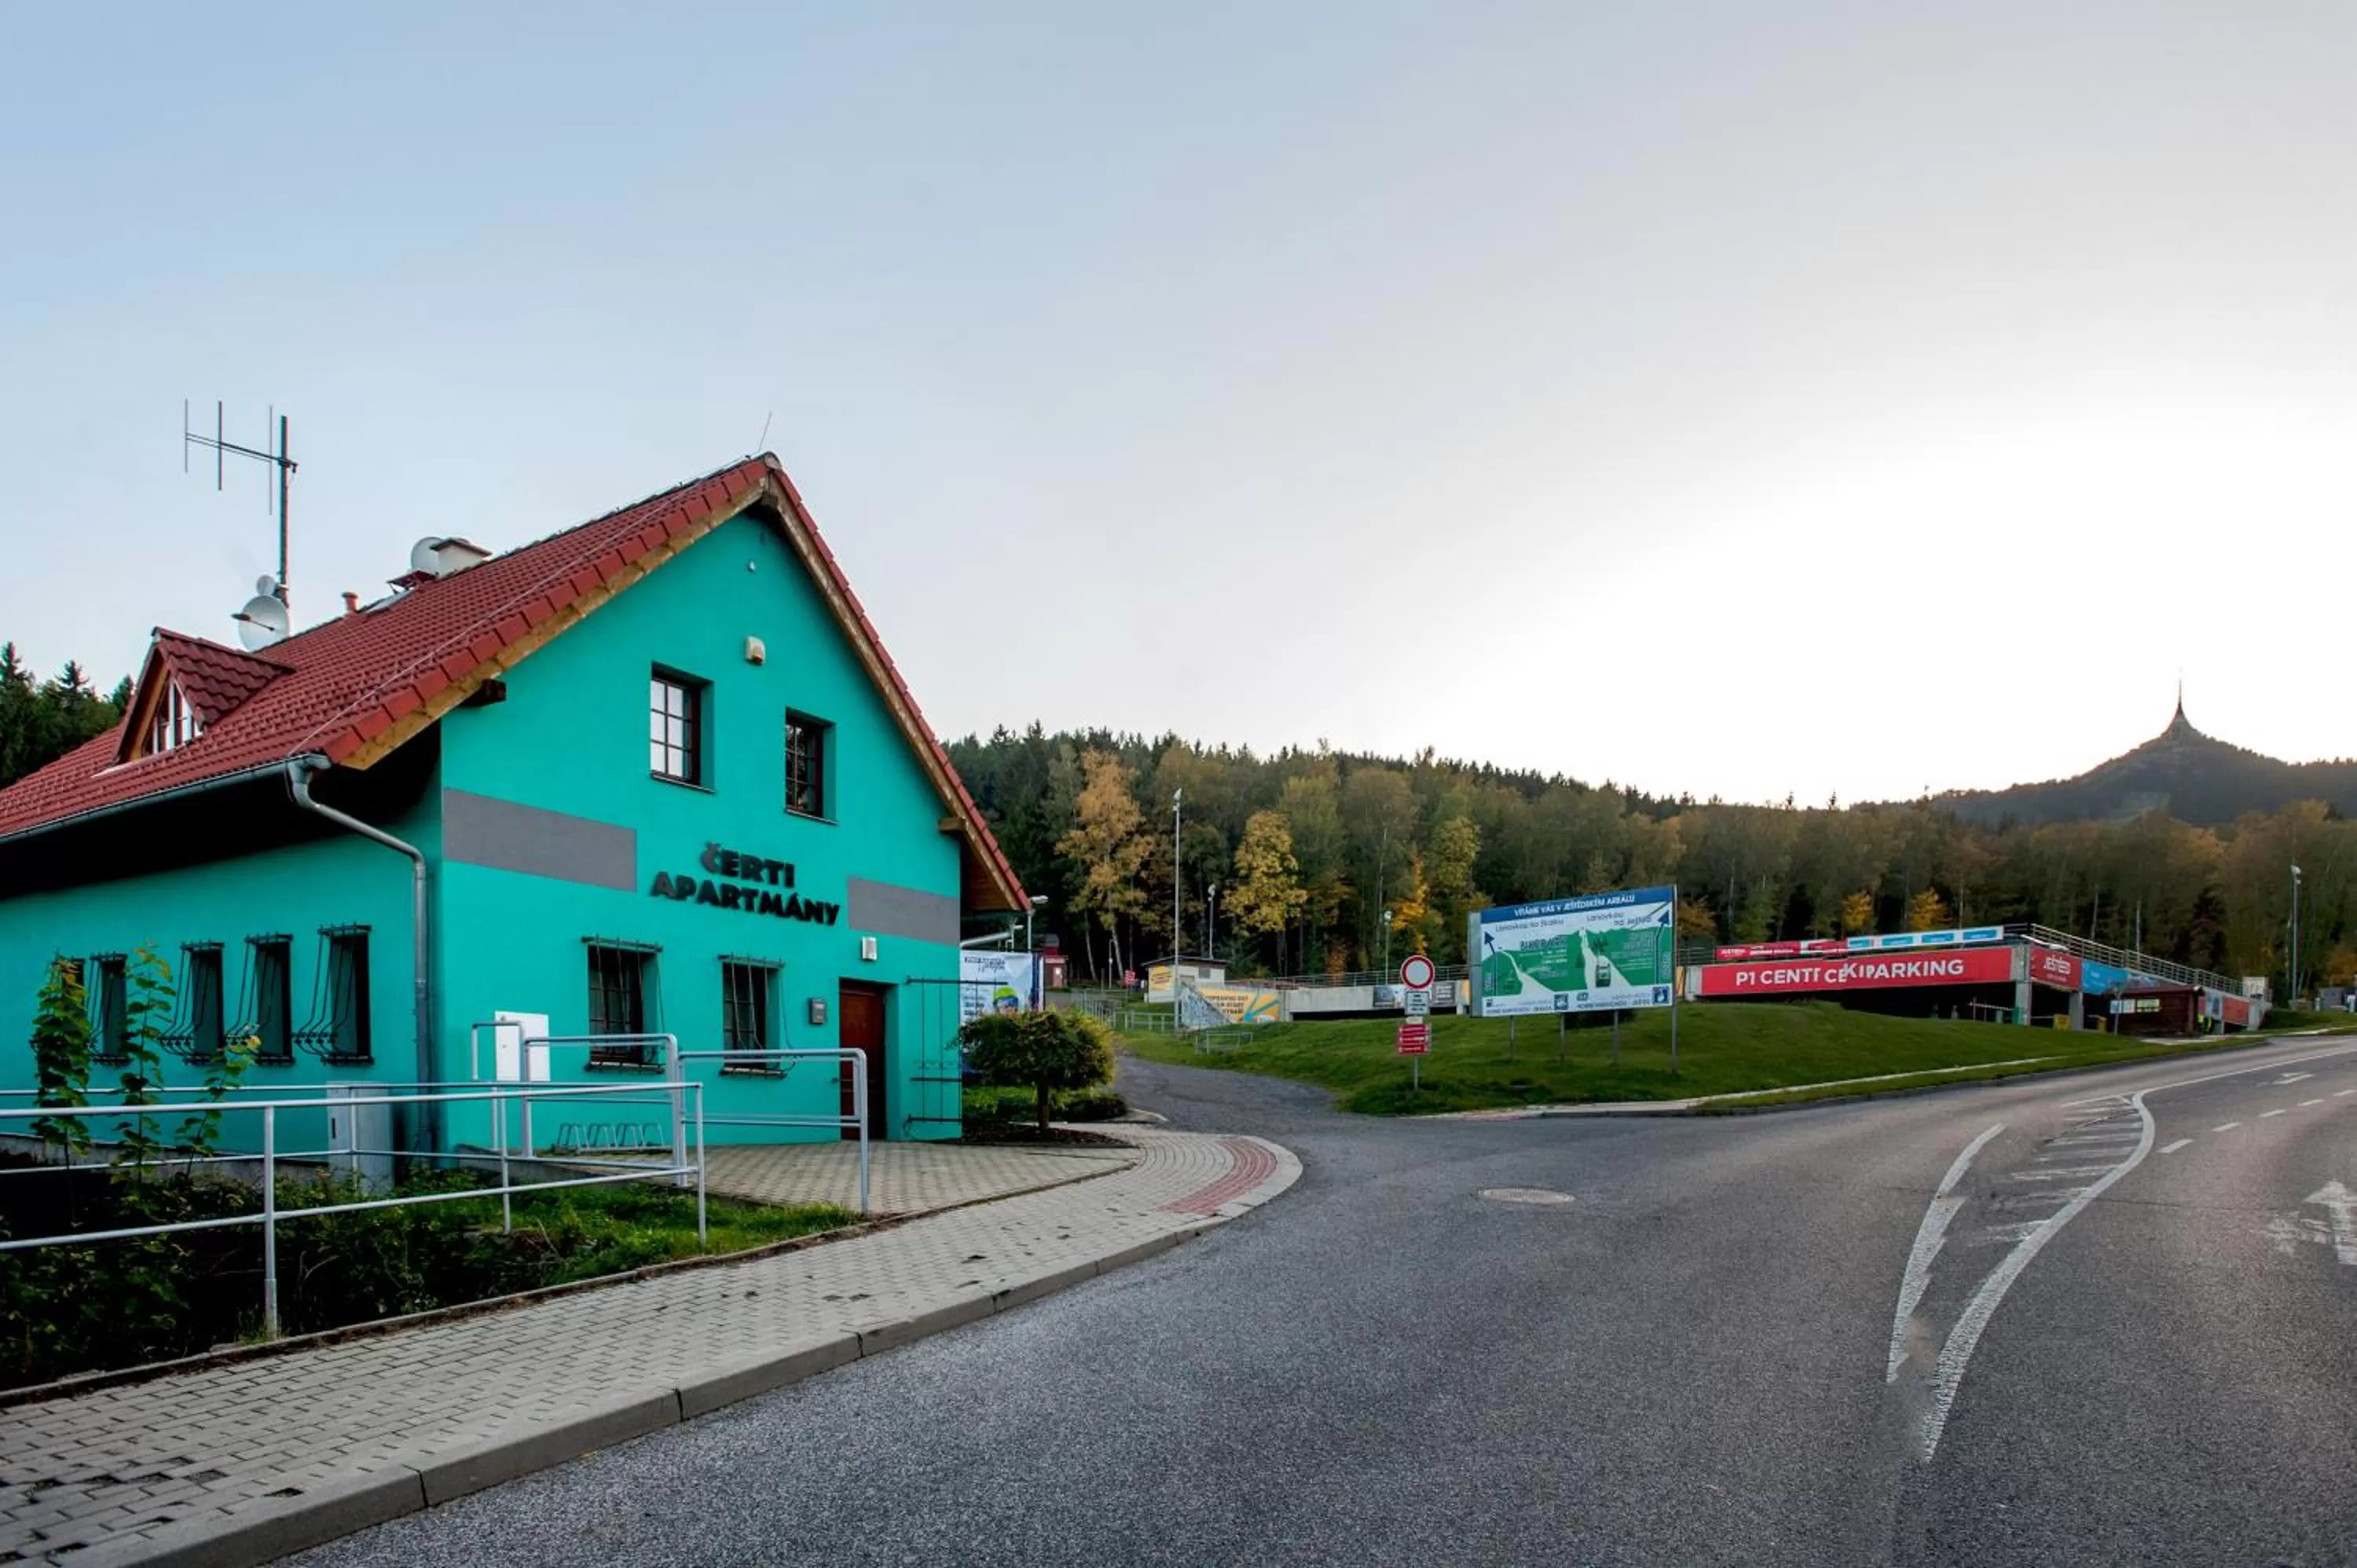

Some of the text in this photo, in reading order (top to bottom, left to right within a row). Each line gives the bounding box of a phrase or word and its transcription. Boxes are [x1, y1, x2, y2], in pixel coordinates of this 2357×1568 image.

[700, 841, 795, 888] ČERTI
[650, 871, 840, 925] APARTMÁNY
[1736, 971, 1756, 986] P1
